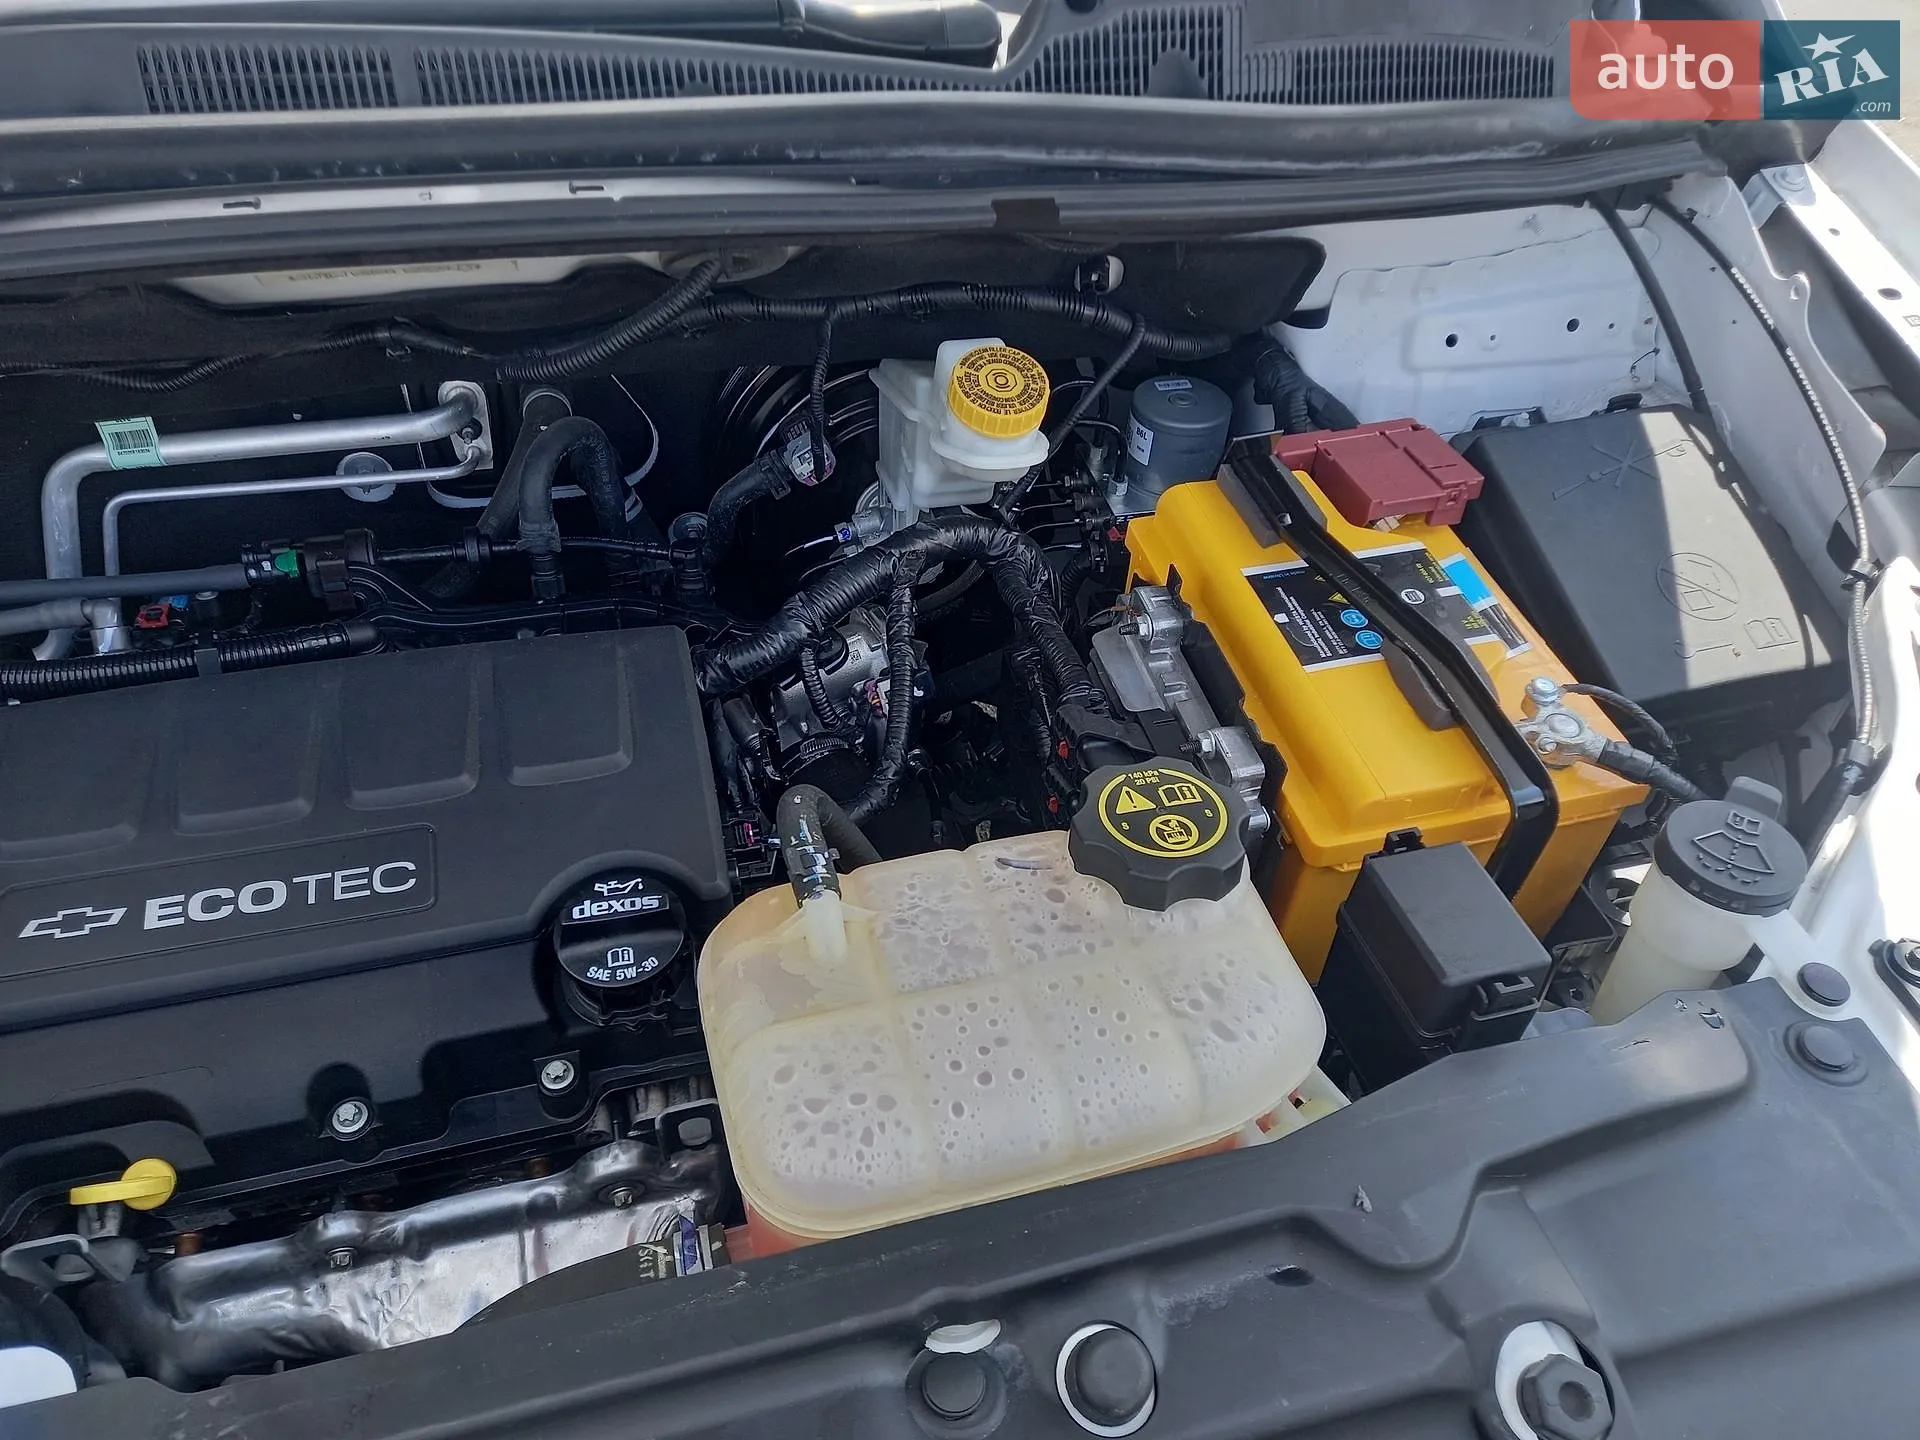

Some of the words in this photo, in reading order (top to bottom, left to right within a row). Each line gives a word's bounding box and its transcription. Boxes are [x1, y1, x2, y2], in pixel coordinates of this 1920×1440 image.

[143, 861, 417, 930] ECOTEC
[572, 895, 662, 919] dexos
[586, 966, 611, 981] SAE
[616, 956, 659, 980] 5W-30
